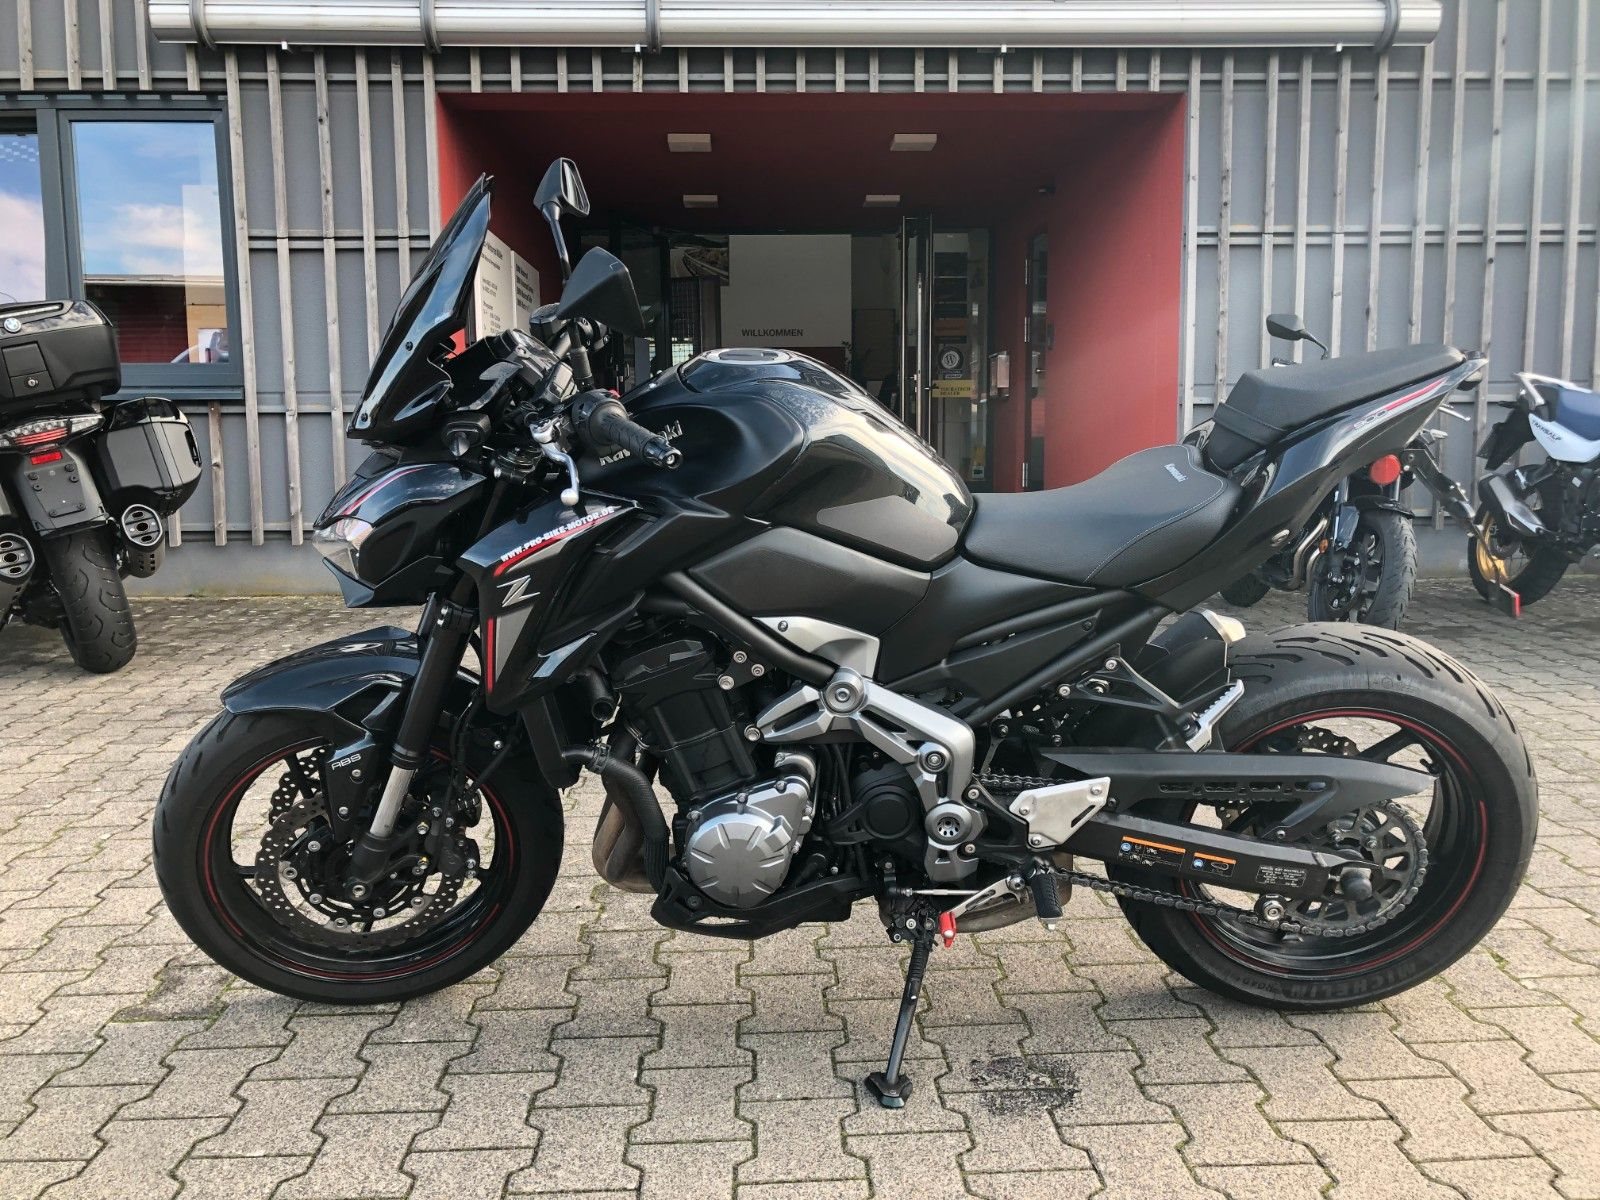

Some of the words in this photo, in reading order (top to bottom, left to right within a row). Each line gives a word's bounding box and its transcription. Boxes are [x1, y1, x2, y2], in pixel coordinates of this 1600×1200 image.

[741, 328, 804, 337] WILLKOMMEN
[500, 506, 615, 562] WWW.PRO-BIKE-MOTOR.DE
[331, 753, 361, 771] ABS
[1290, 963, 1417, 997] MICHELIN
